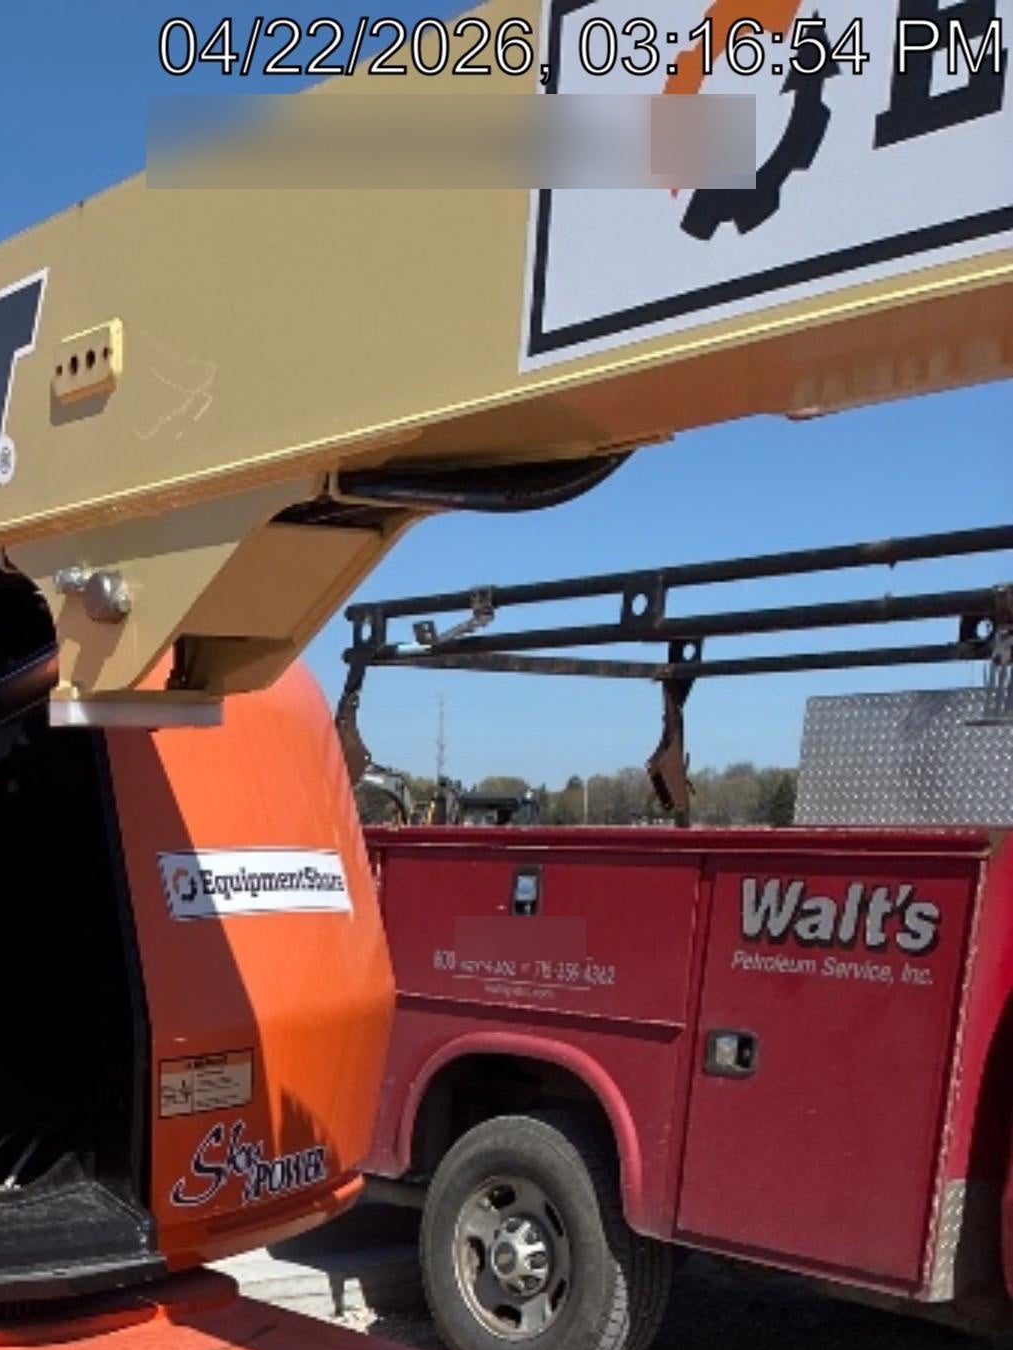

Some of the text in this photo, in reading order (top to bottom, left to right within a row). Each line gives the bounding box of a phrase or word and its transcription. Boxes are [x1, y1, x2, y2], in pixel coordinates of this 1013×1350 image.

[199, 866, 344, 900] EquipmentShare
[742, 877, 940, 955] Walt's
[731, 950, 933, 985] Petroleum Service, Inc.
[251, 1146, 326, 1200] POWER
